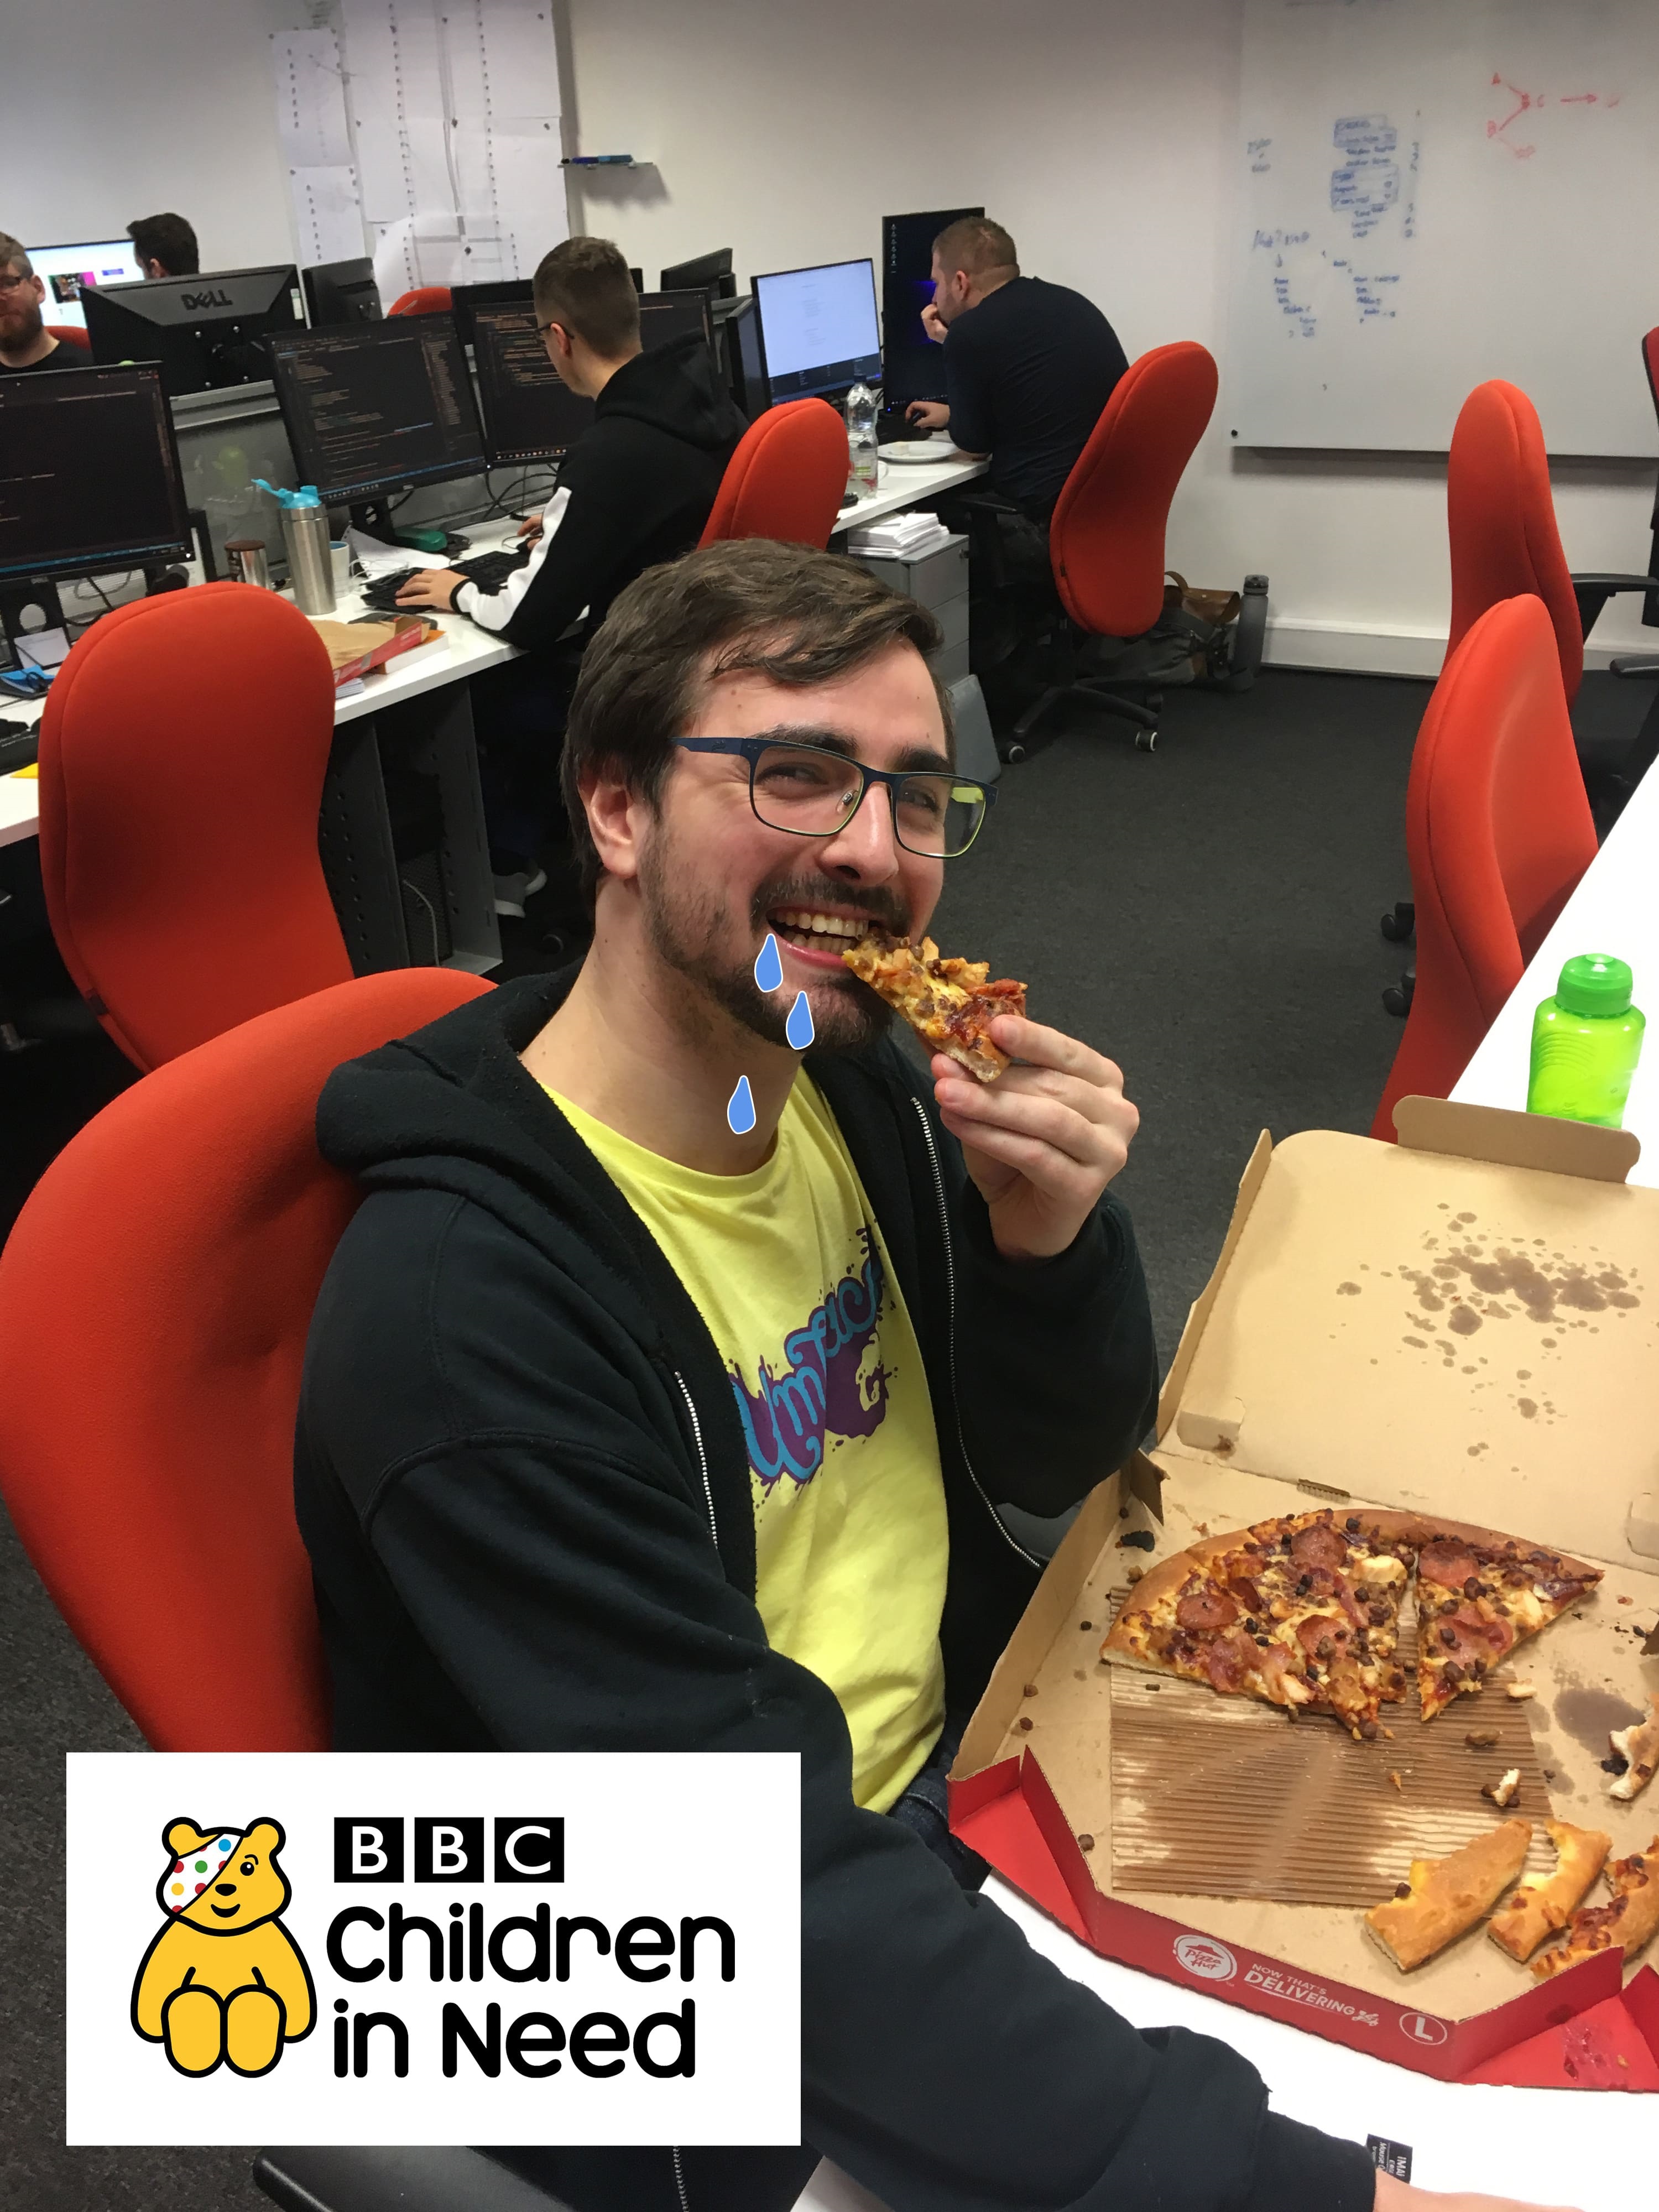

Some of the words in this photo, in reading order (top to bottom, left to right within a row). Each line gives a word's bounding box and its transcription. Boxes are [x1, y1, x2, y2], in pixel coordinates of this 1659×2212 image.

[180, 289, 233, 310] DELL
[1185, 1949, 1222, 1965] Pizza
[1191, 1959, 1220, 1970] Hut
[1252, 1963, 1284, 1979] NOW
[1287, 1976, 1327, 1995] THAT'S
[1244, 1970, 1355, 2015] DELIVERING
[1415, 2016, 1433, 2041] L
